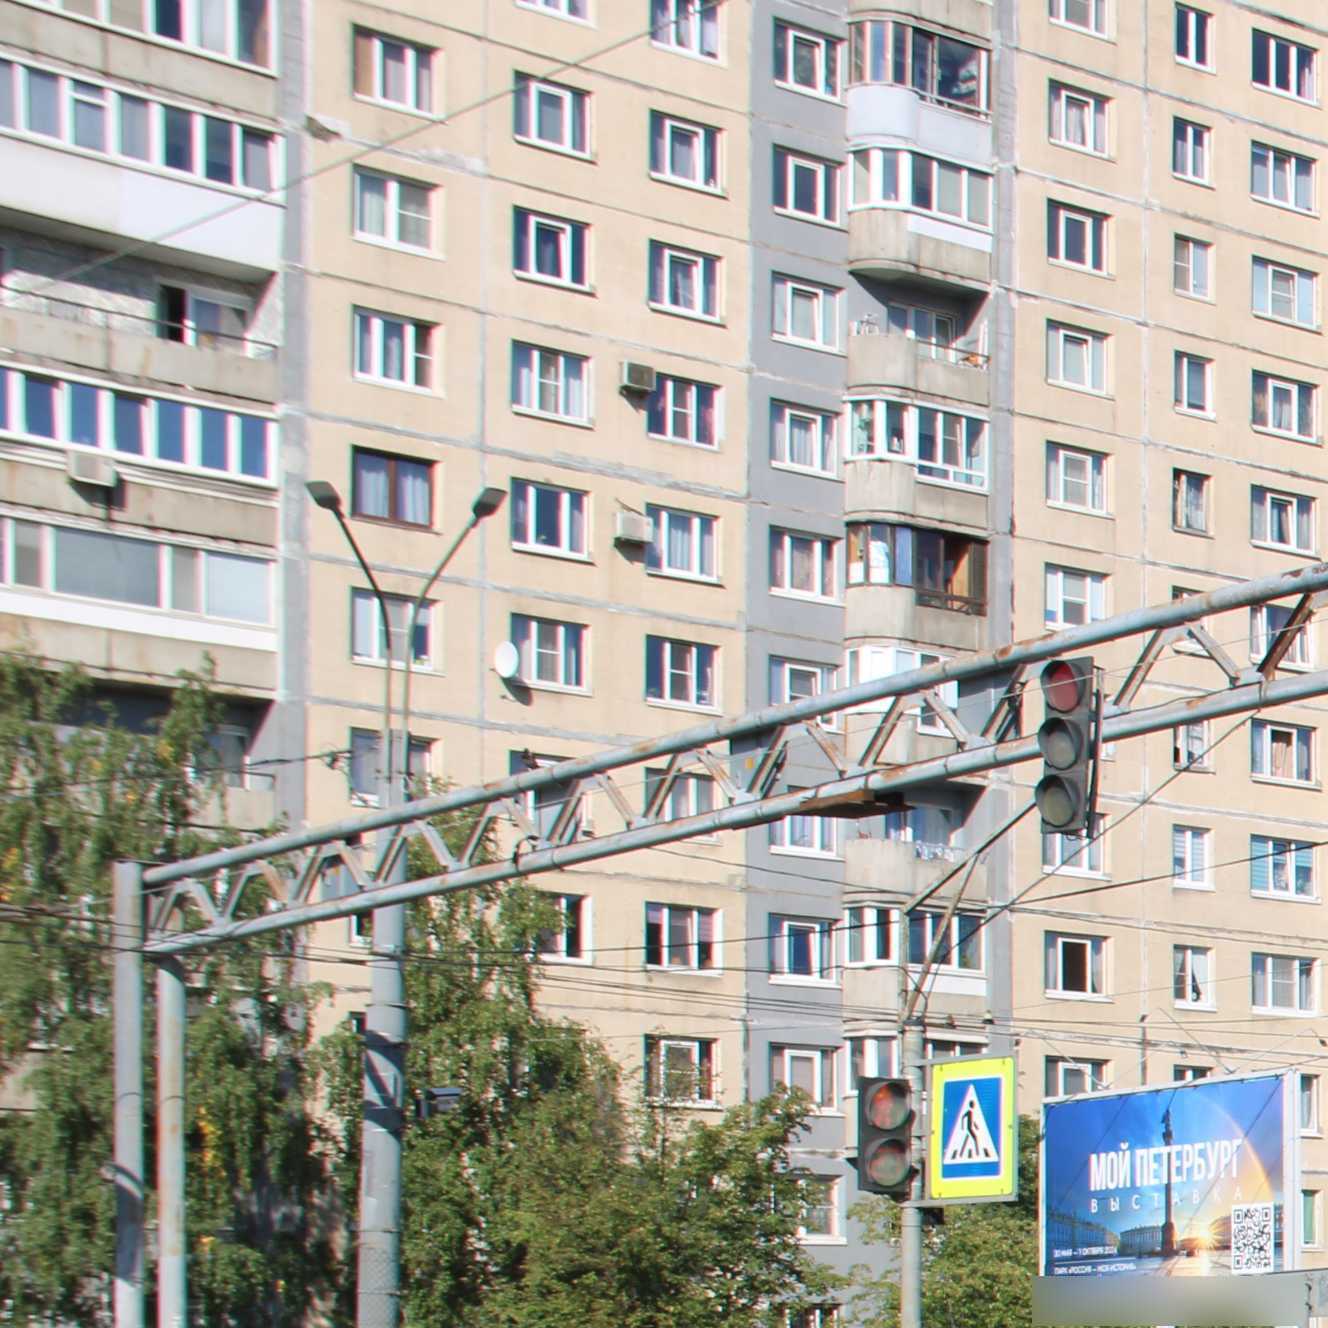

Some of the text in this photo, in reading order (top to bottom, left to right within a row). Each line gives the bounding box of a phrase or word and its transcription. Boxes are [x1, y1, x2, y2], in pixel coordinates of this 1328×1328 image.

[1090, 1138, 1243, 1192] МОЙ ПЕТЕРБУРГ
[1091, 1186, 1242, 1214] ВЫСТАВКА
